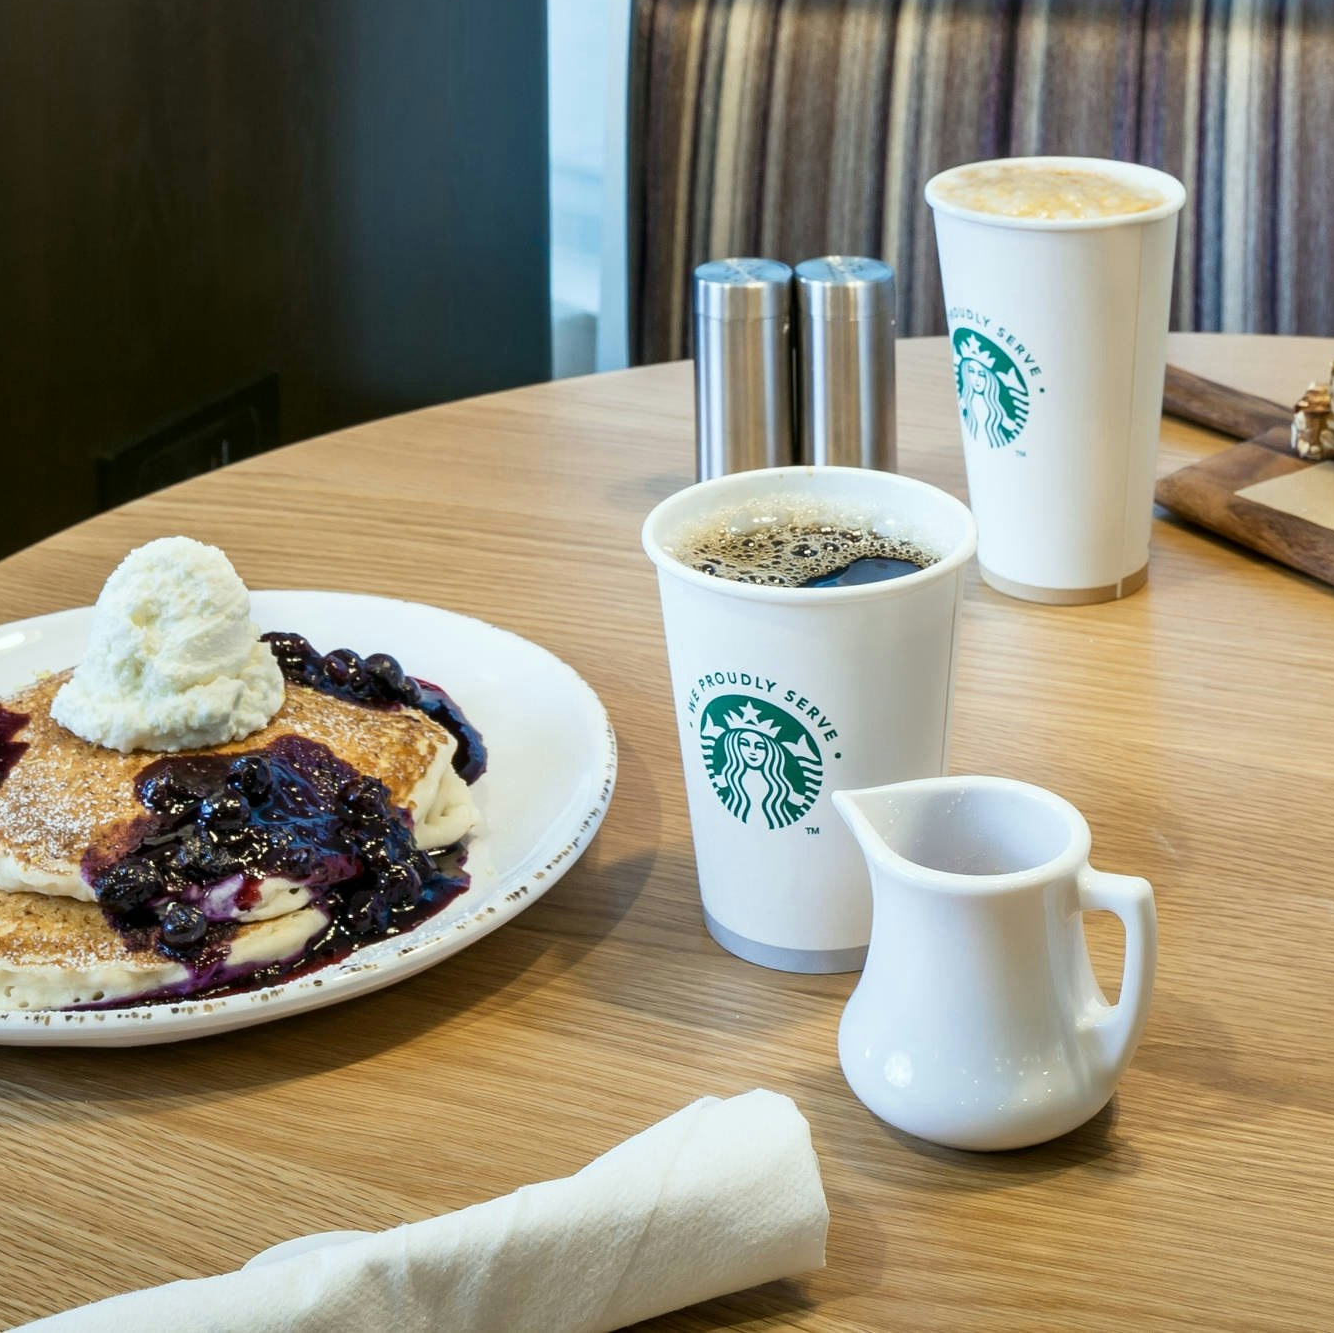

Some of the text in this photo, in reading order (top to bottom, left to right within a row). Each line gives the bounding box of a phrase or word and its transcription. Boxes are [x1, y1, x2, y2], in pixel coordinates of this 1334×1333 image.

[996, 327, 1042, 377] SERVE
[687, 671, 839, 743] WE PROUDLY SERVE
[805, 827, 820, 835] TM
